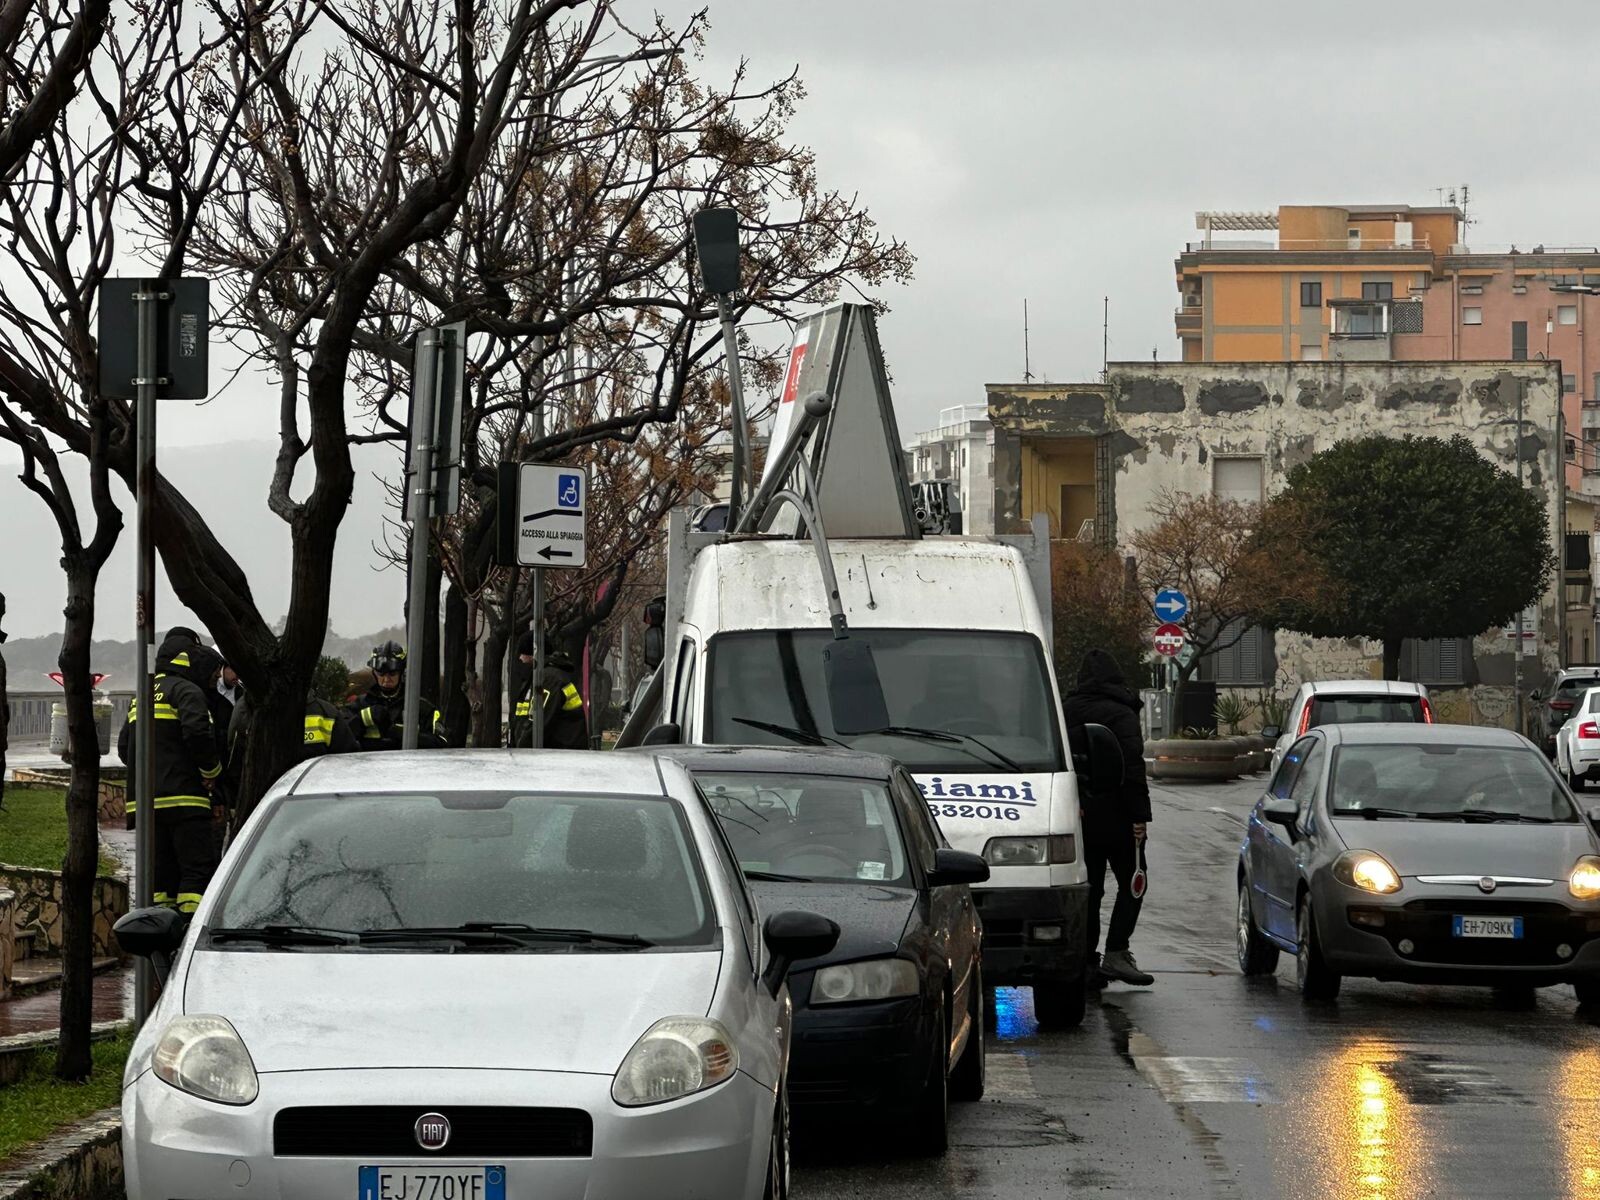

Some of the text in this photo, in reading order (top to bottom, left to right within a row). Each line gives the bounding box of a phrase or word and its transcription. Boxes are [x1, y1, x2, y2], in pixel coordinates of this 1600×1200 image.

[522, 529, 583, 541] ACCESSO ALLA SPIAGGIA
[422, 1124, 444, 1140] FIAT
